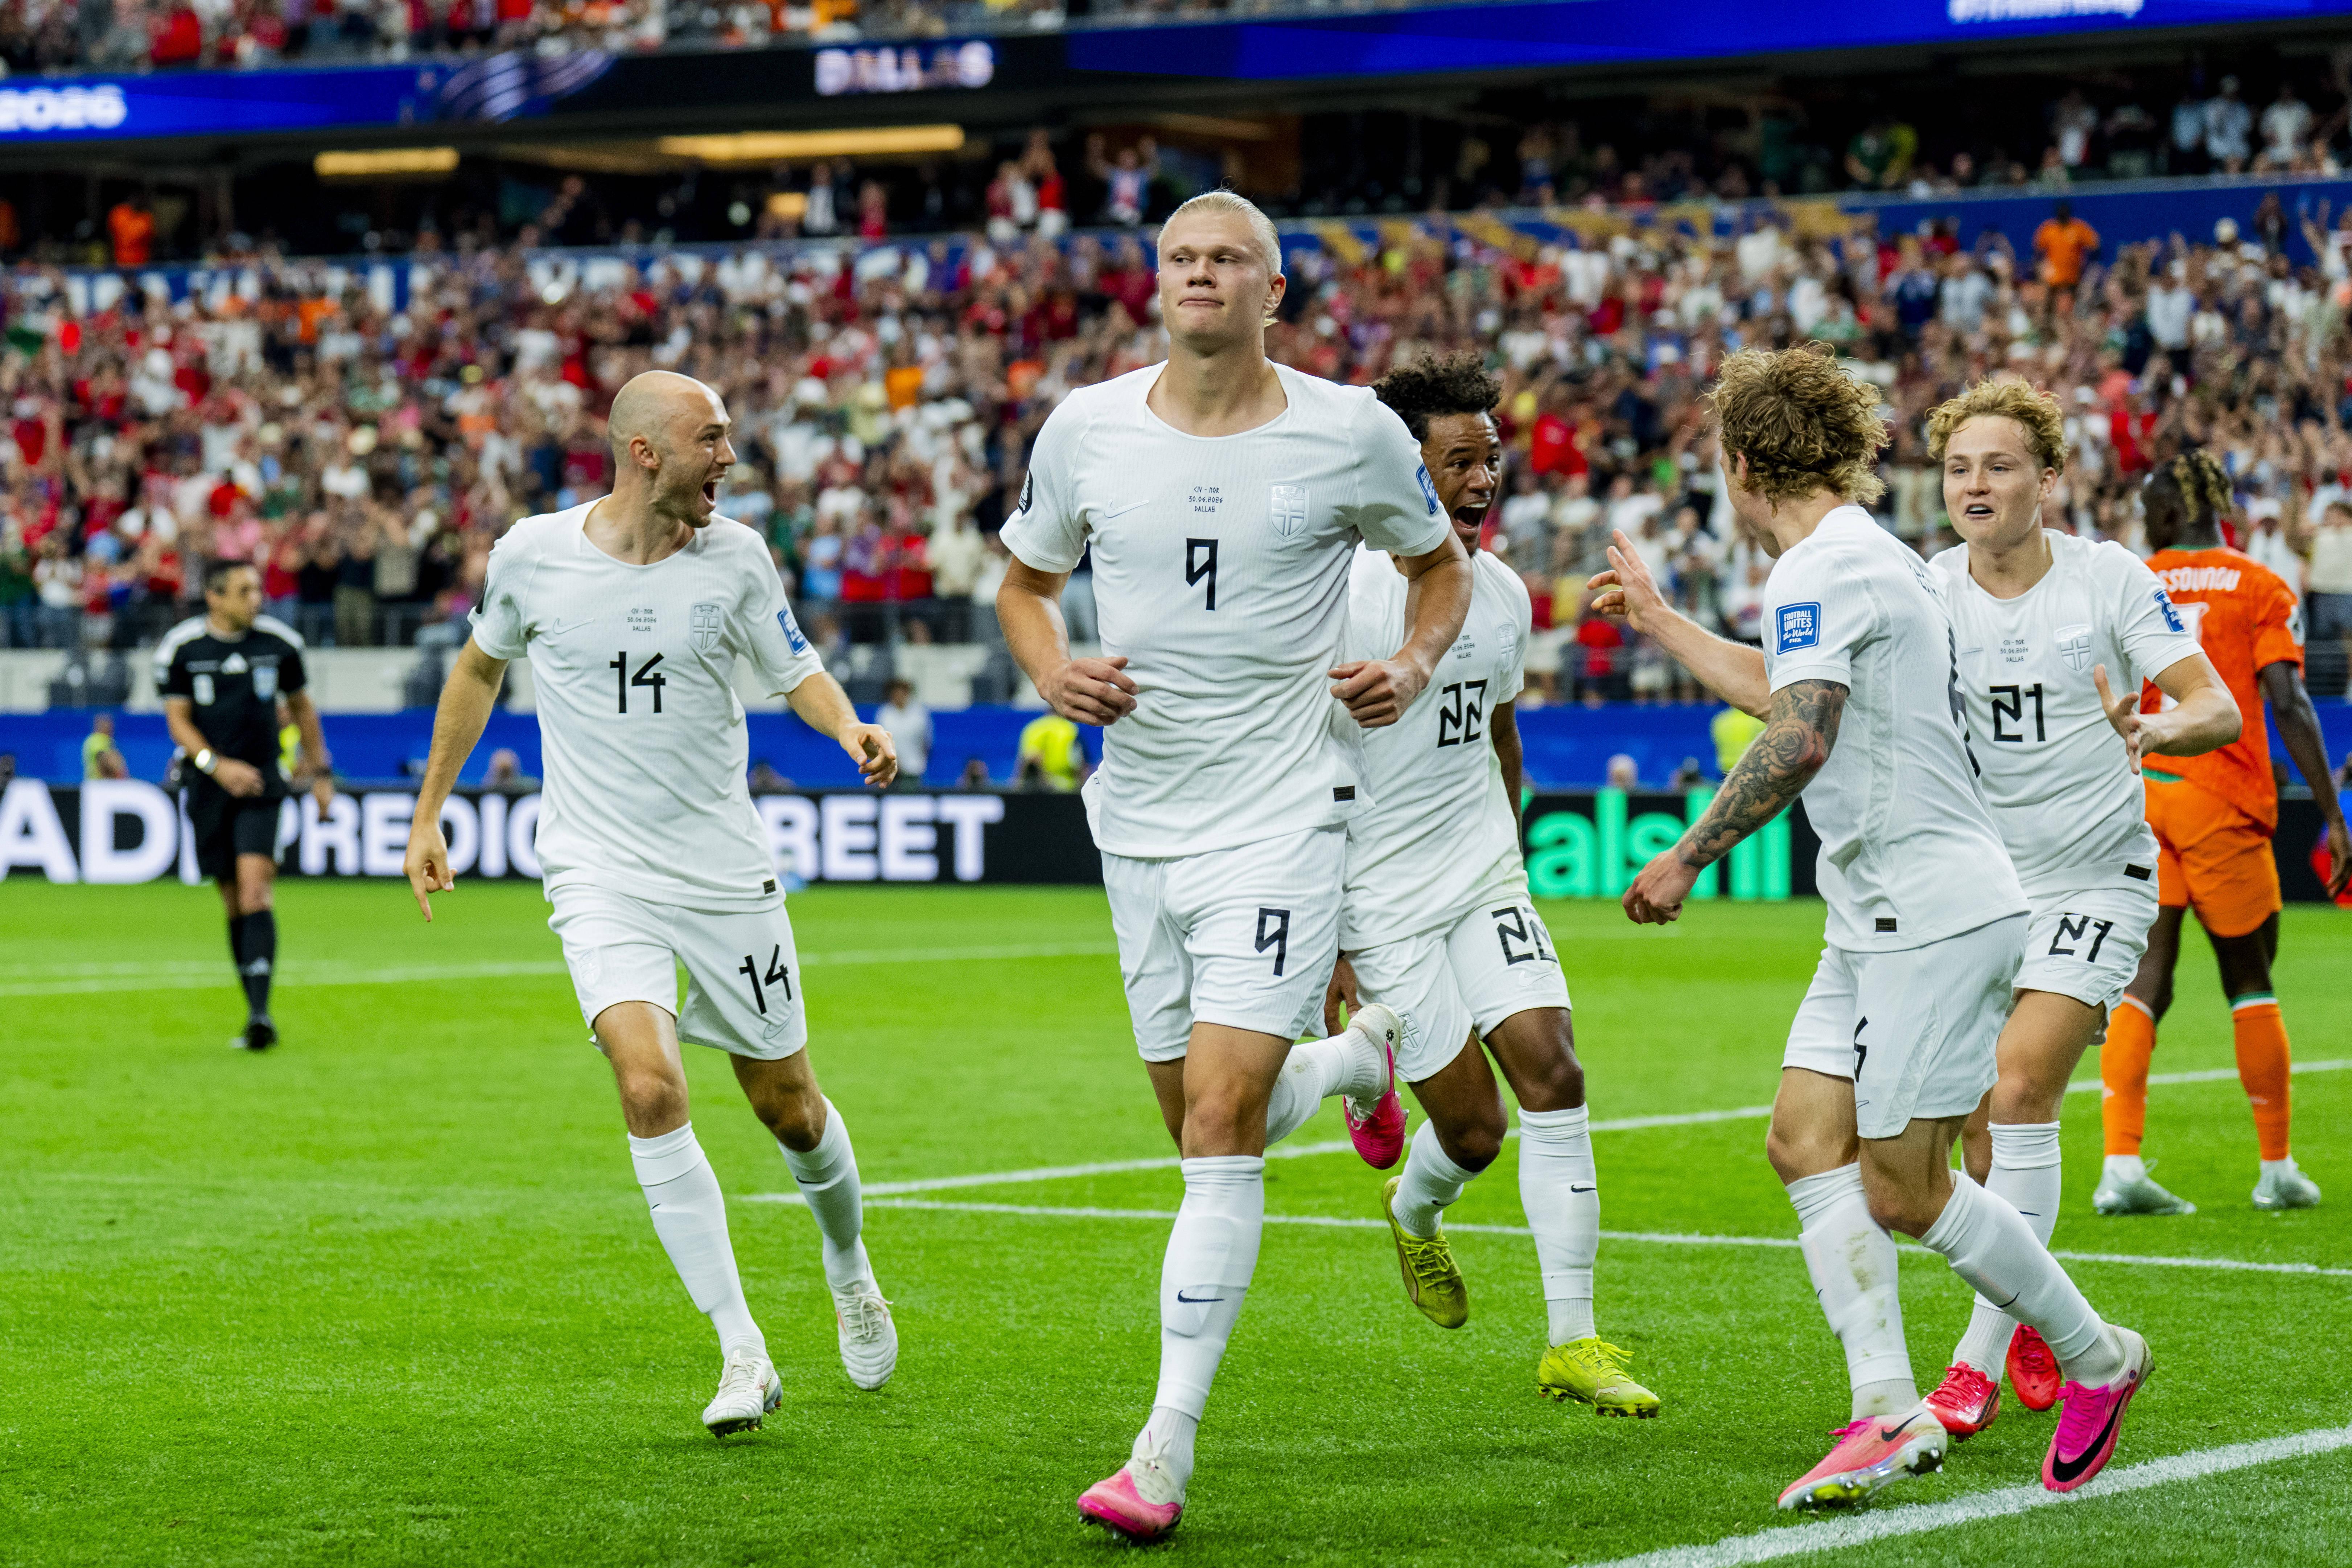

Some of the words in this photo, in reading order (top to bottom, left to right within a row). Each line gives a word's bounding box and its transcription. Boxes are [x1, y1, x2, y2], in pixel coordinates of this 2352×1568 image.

[1186, 538, 1219, 611] 9
[1783, 631, 1792, 641] the
[1792, 627, 1813, 638] World
[1784, 610, 1812, 621] FOOTBALL
[1784, 618, 1812, 631] UNITES
[610, 651, 666, 713] 14
[1437, 678, 1488, 748] 22
[1989, 683, 2046, 742] 21
[1255, 908, 1290, 977] 9
[2048, 912, 2114, 963] 21
[738, 943, 792, 1015] 14
